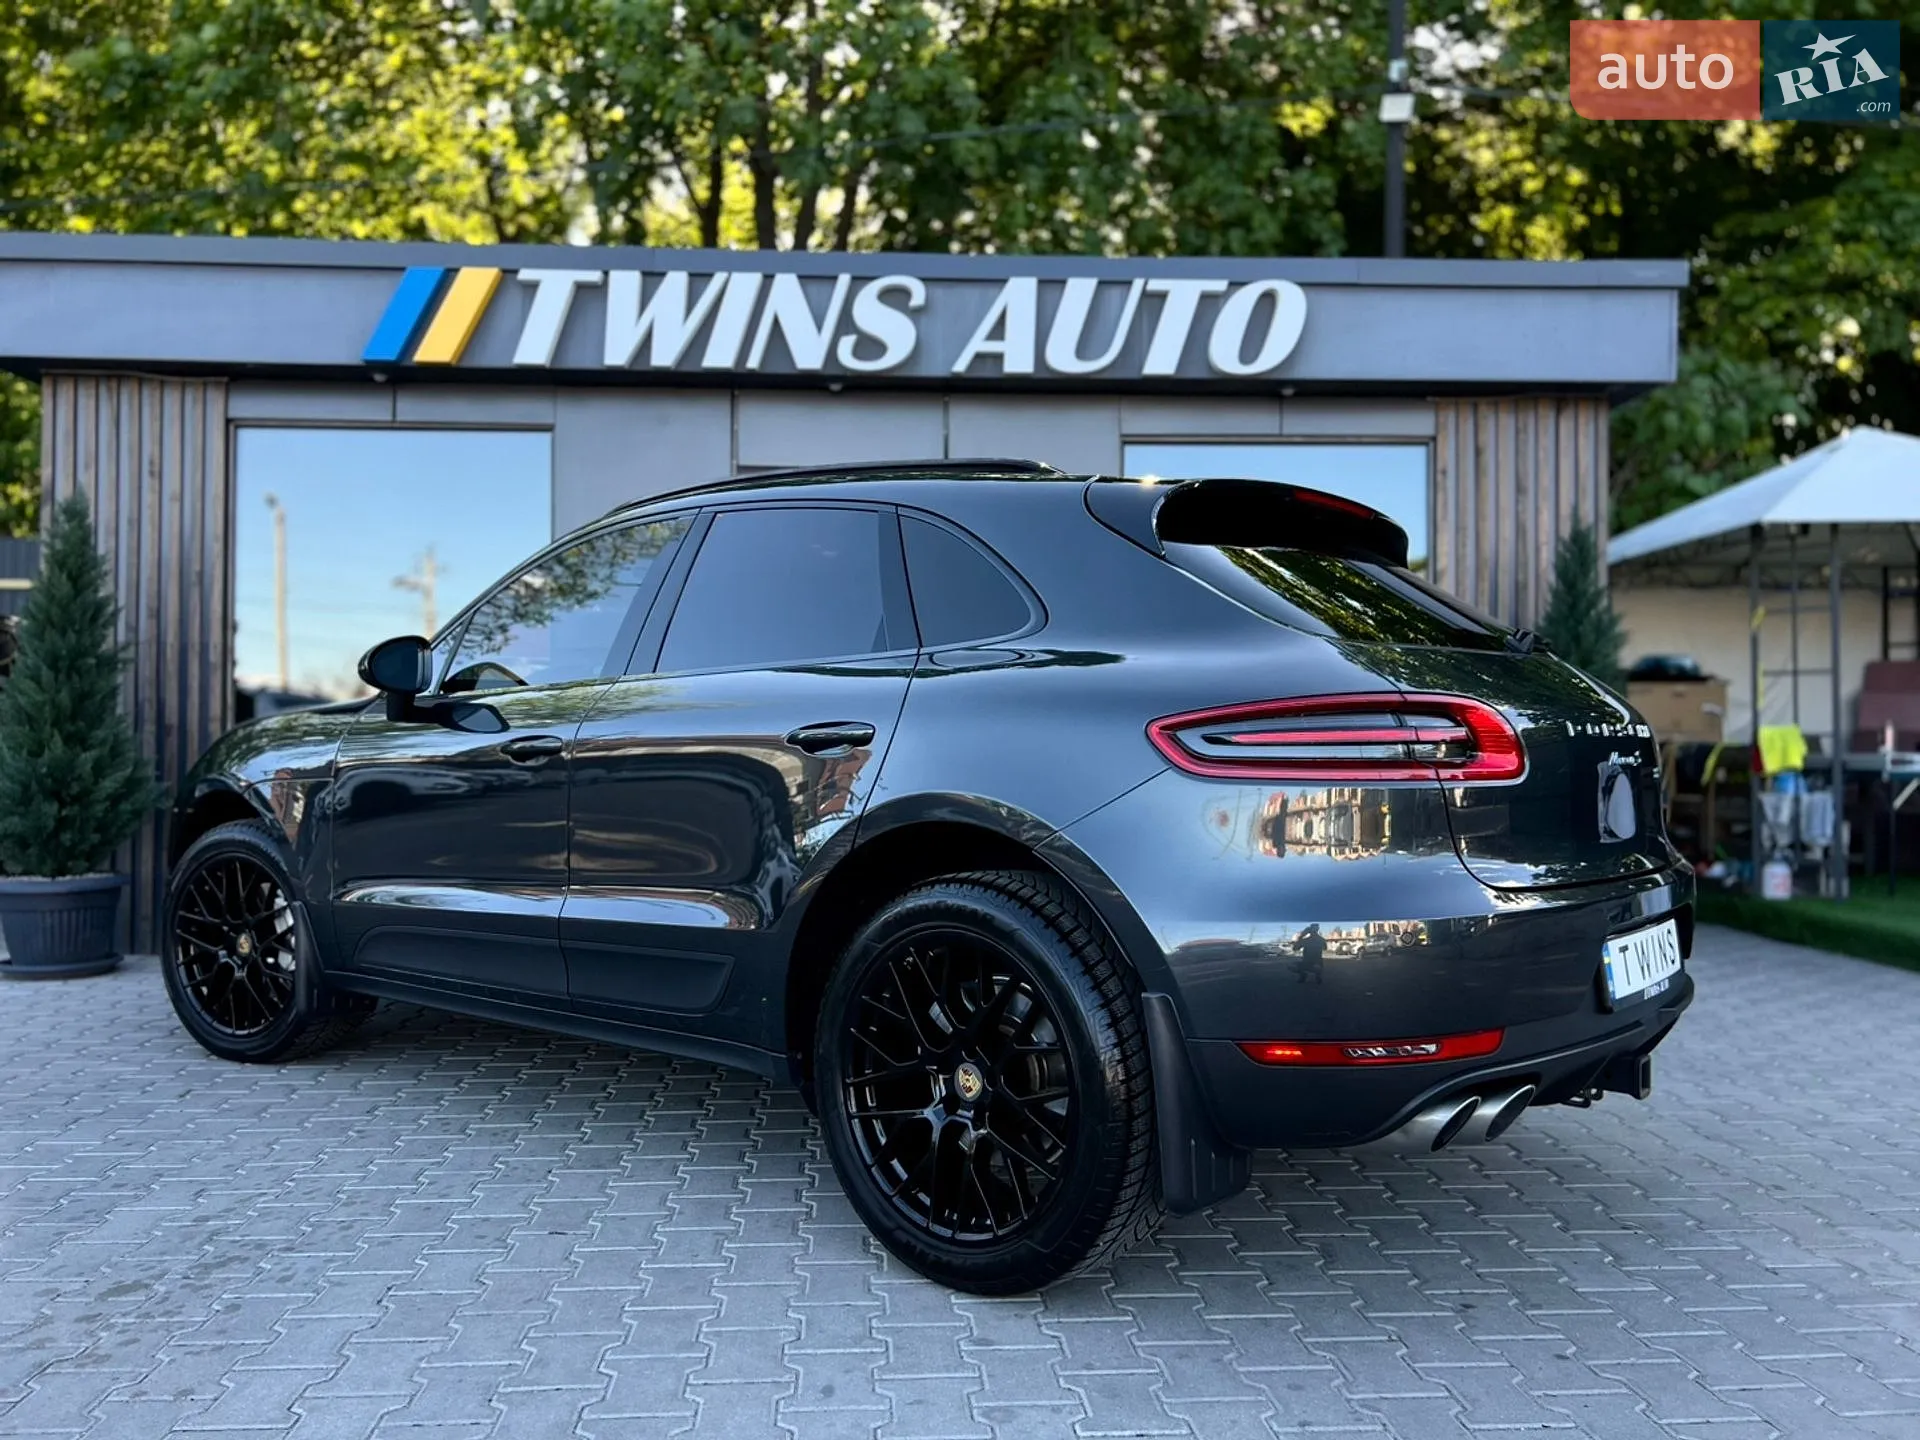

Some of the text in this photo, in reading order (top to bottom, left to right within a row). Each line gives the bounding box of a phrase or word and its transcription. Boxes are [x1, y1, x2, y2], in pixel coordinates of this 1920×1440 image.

[511, 267, 1308, 375] TWINS AUTO
[1618, 928, 1676, 987] TWINS
